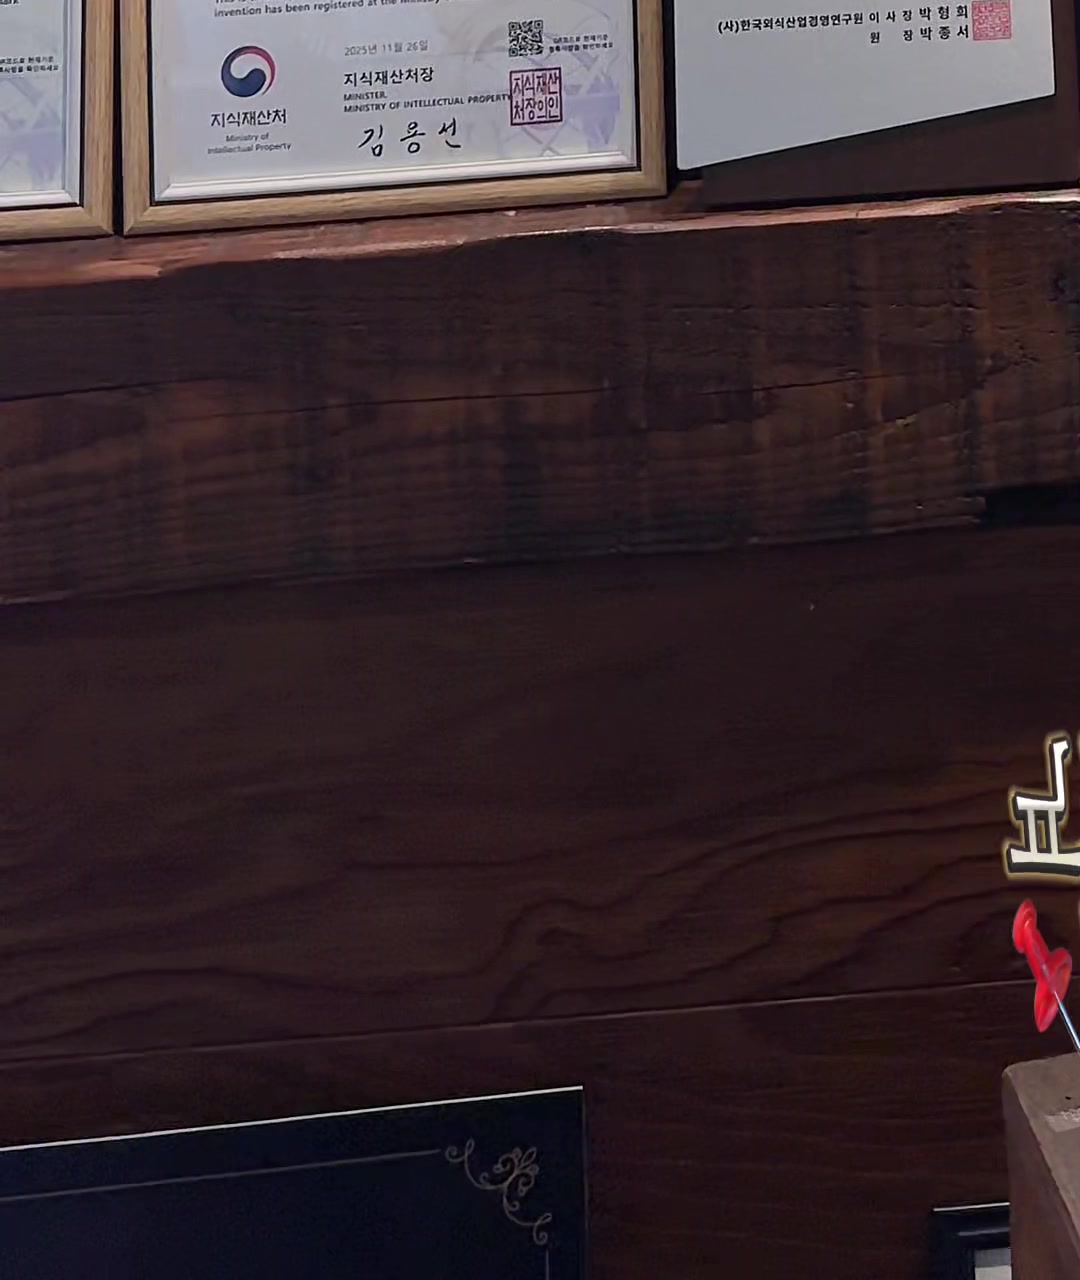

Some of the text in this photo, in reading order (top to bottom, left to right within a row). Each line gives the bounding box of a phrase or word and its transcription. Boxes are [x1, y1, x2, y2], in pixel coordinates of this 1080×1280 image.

[214, 5, 261, 17] invention
[265, 4, 283, 14] has
[286, 2, 310, 13] been
[718, 12, 863, 34] (사)한국외식산업경영연구원
[343, 66, 434, 87] 지식재산처장
[211, 109, 287, 128] 지식재산처
